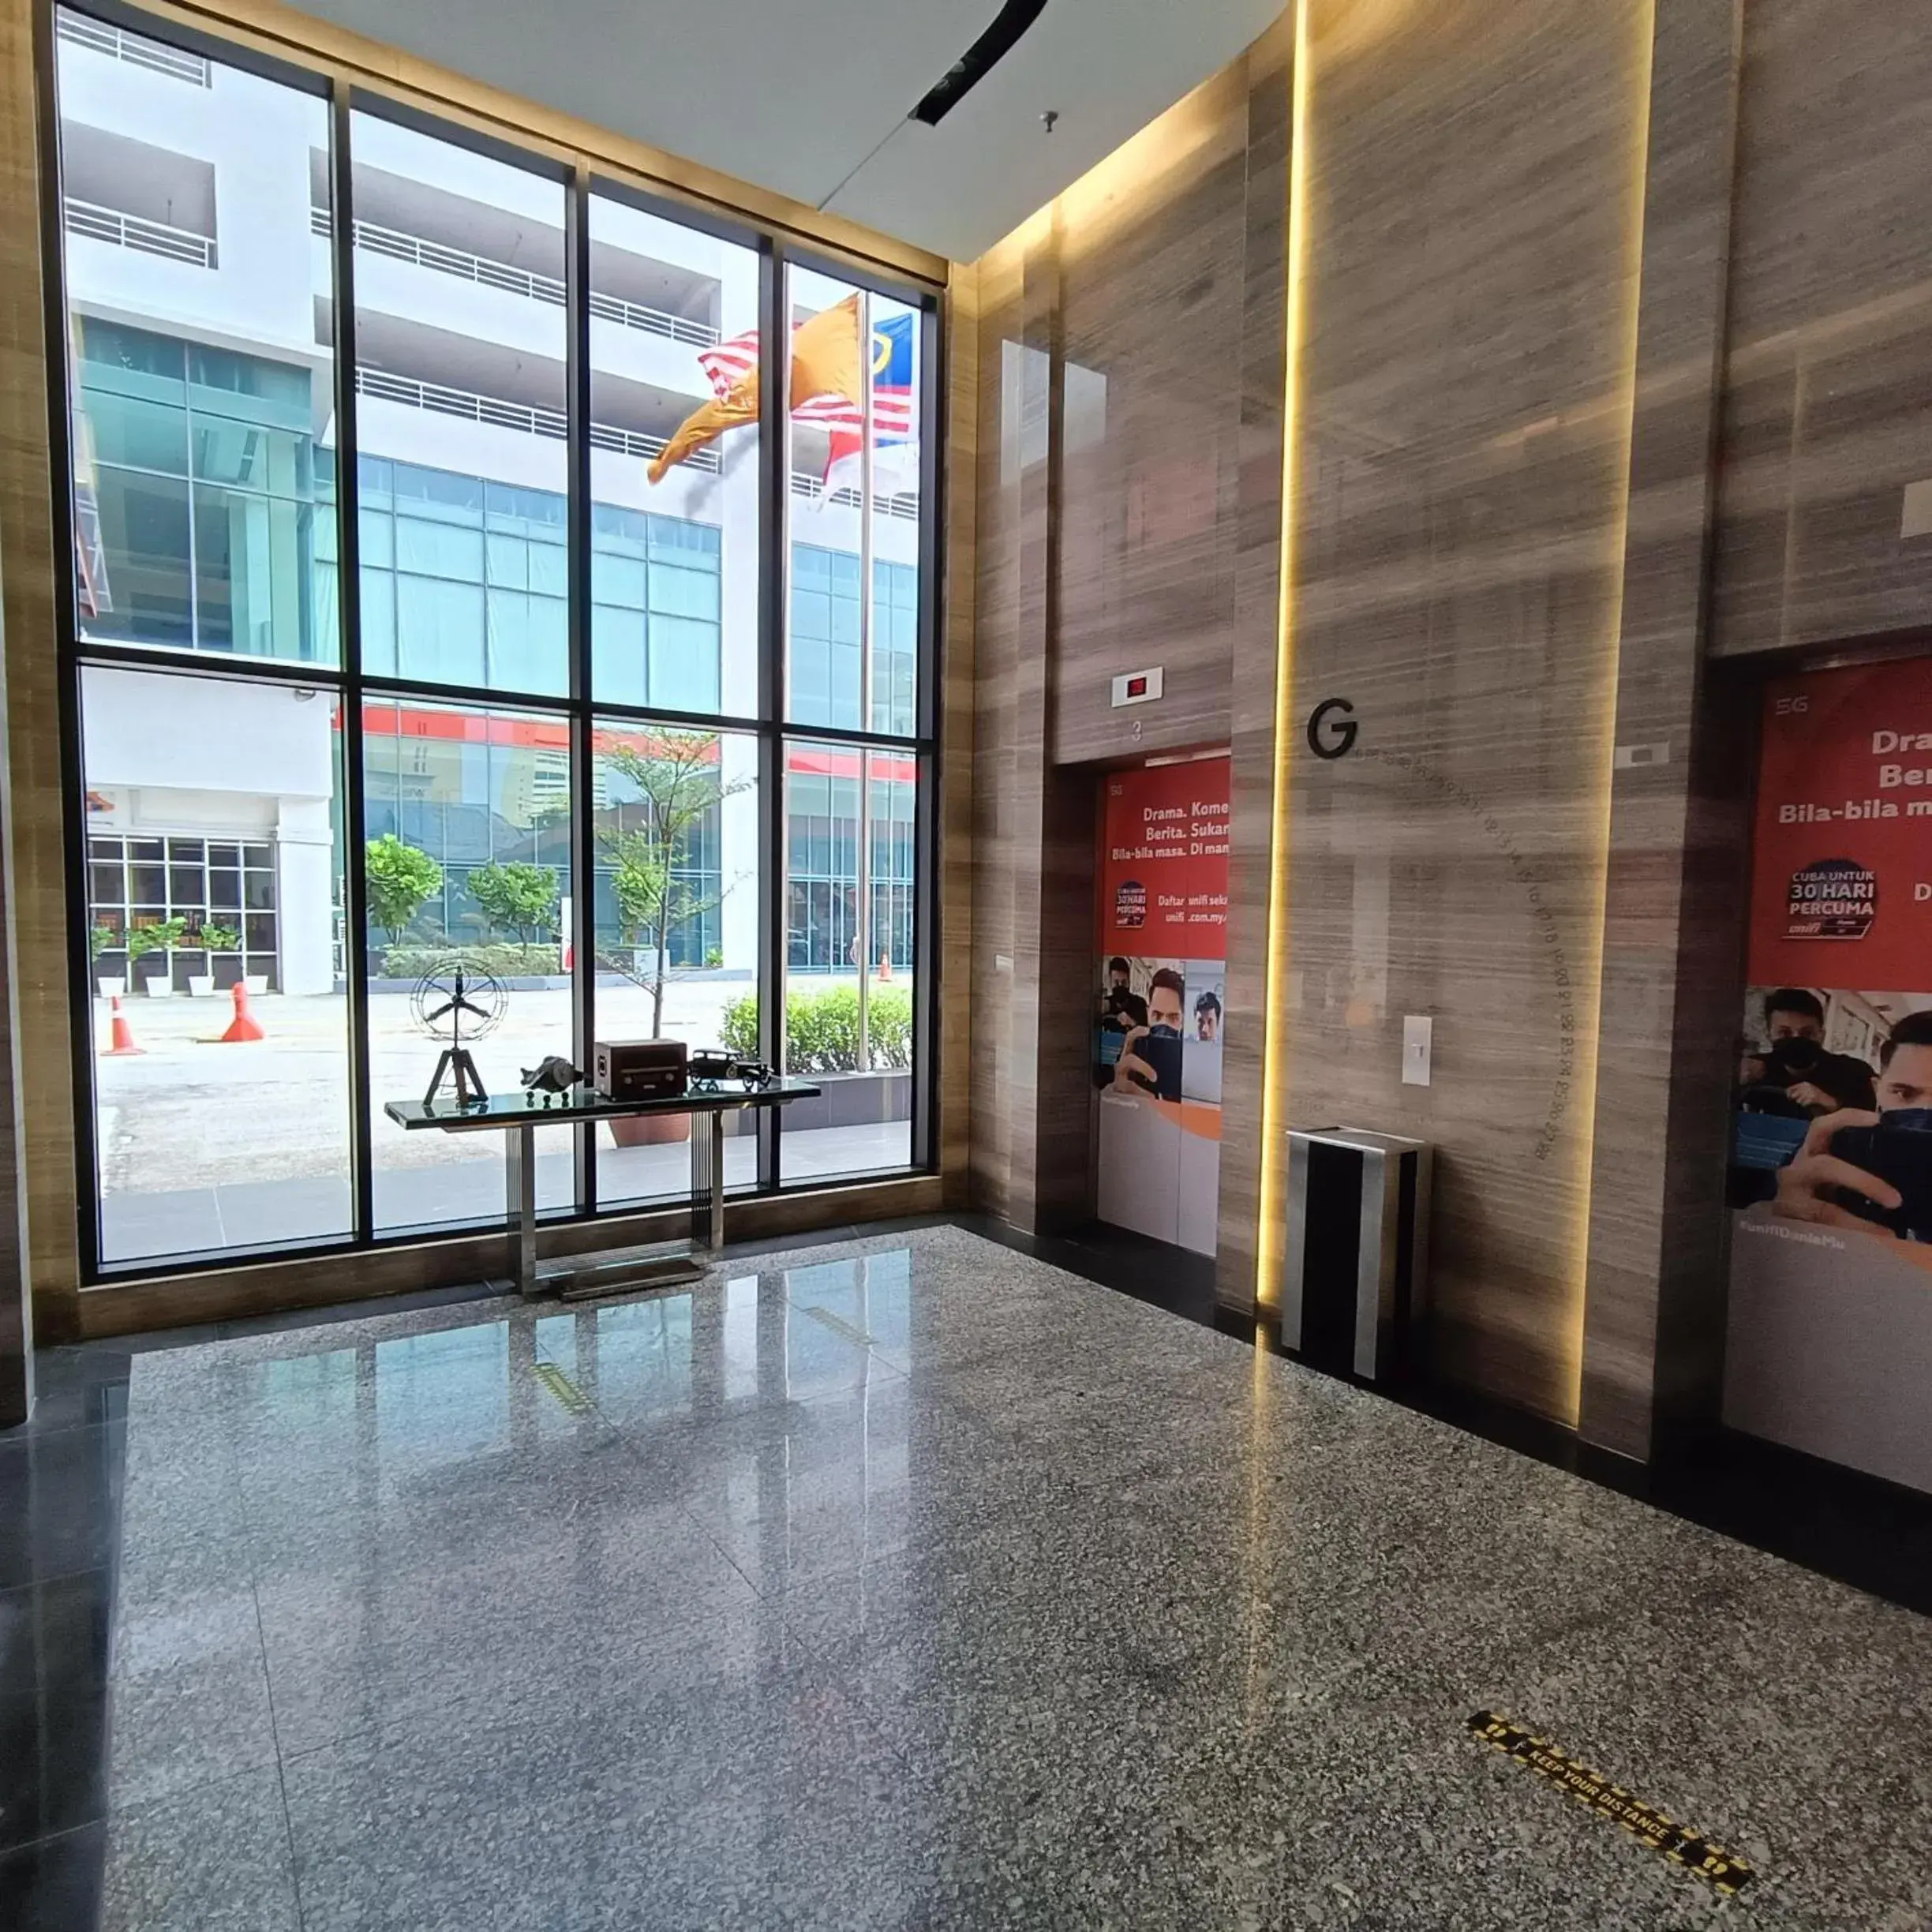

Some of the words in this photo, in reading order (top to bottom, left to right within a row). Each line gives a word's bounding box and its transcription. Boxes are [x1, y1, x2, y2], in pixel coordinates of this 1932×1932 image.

[1307, 698, 1358, 758] G
[1144, 807, 1187, 822] Drama.
[1192, 801, 1229, 816] Kome
[1779, 799, 1899, 824] Bila-bila
[1146, 826, 1187, 841] Berita.
[1155, 846, 1186, 858] masa.
[1792, 872, 1826, 882] CUBA
[1829, 871, 1874, 881] UNTUK
[1791, 884, 1817, 899] 30
[1822, 882, 1874, 898] HARI
[1789, 901, 1874, 915] PERCUMA
[1529, 1750, 1565, 1773] KEEP
[1563, 1770, 1601, 1796] YOUR
[1598, 1792, 1670, 1840] DISTANCE
